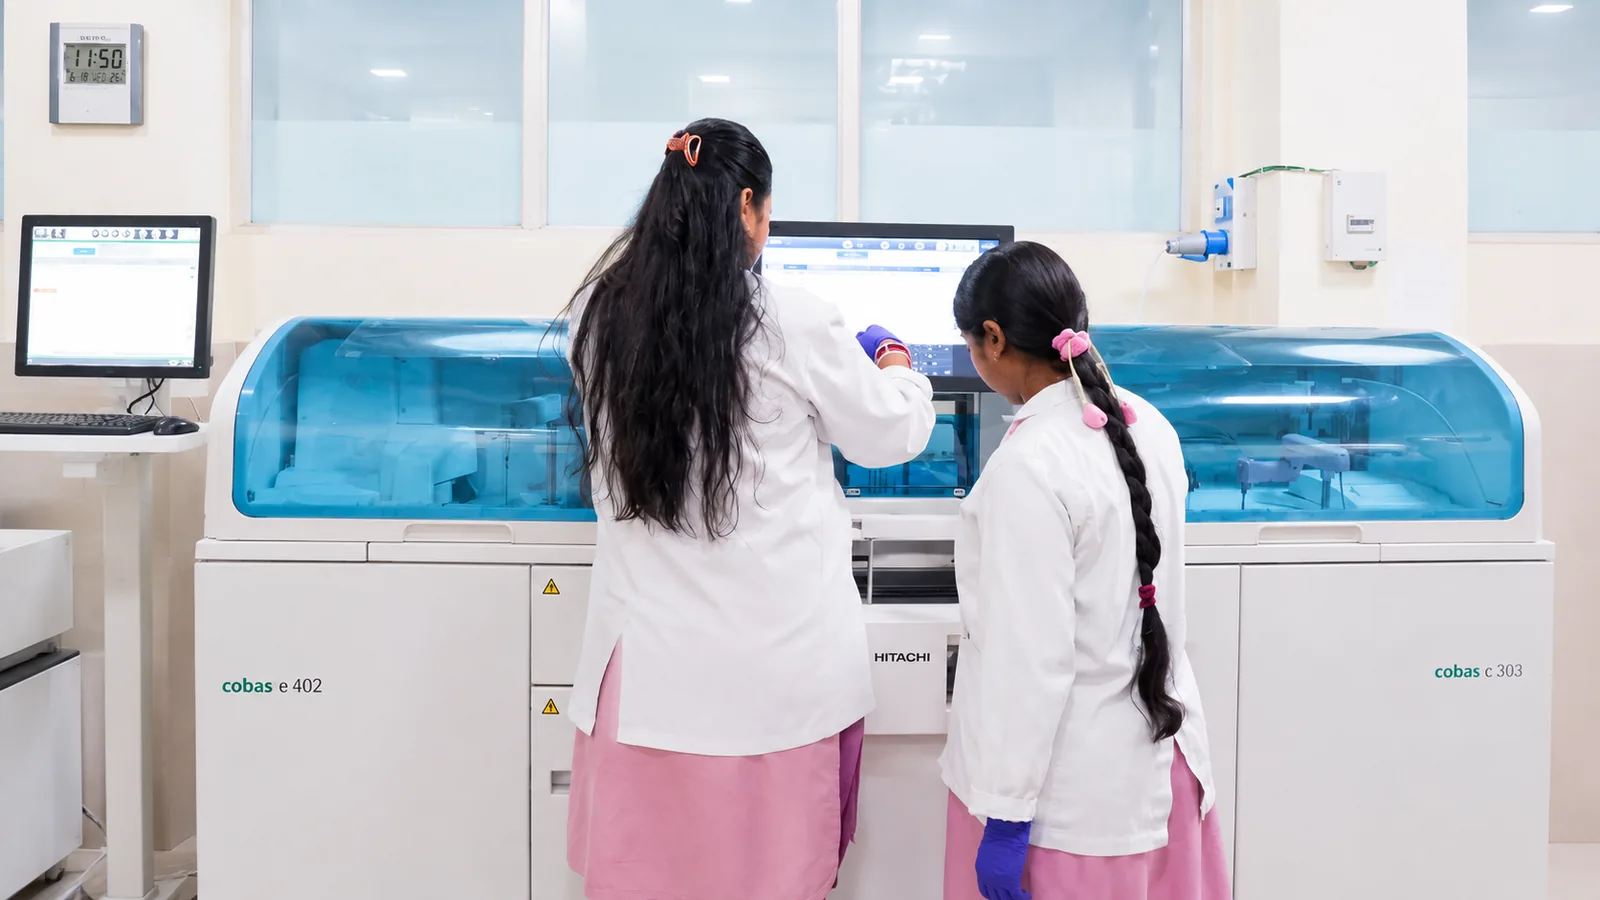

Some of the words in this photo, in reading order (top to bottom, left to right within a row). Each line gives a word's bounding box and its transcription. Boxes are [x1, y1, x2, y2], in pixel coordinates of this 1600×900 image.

[75, 49, 123, 69] 11:50
[874, 652, 931, 663] HITACHI
[1434, 664, 1480, 678] cobas
[1484, 667, 1493, 678] c
[1496, 664, 1523, 678] 303
[221, 677, 273, 693] cobas
[278, 681, 288, 693] e
[292, 678, 323, 693] 402
